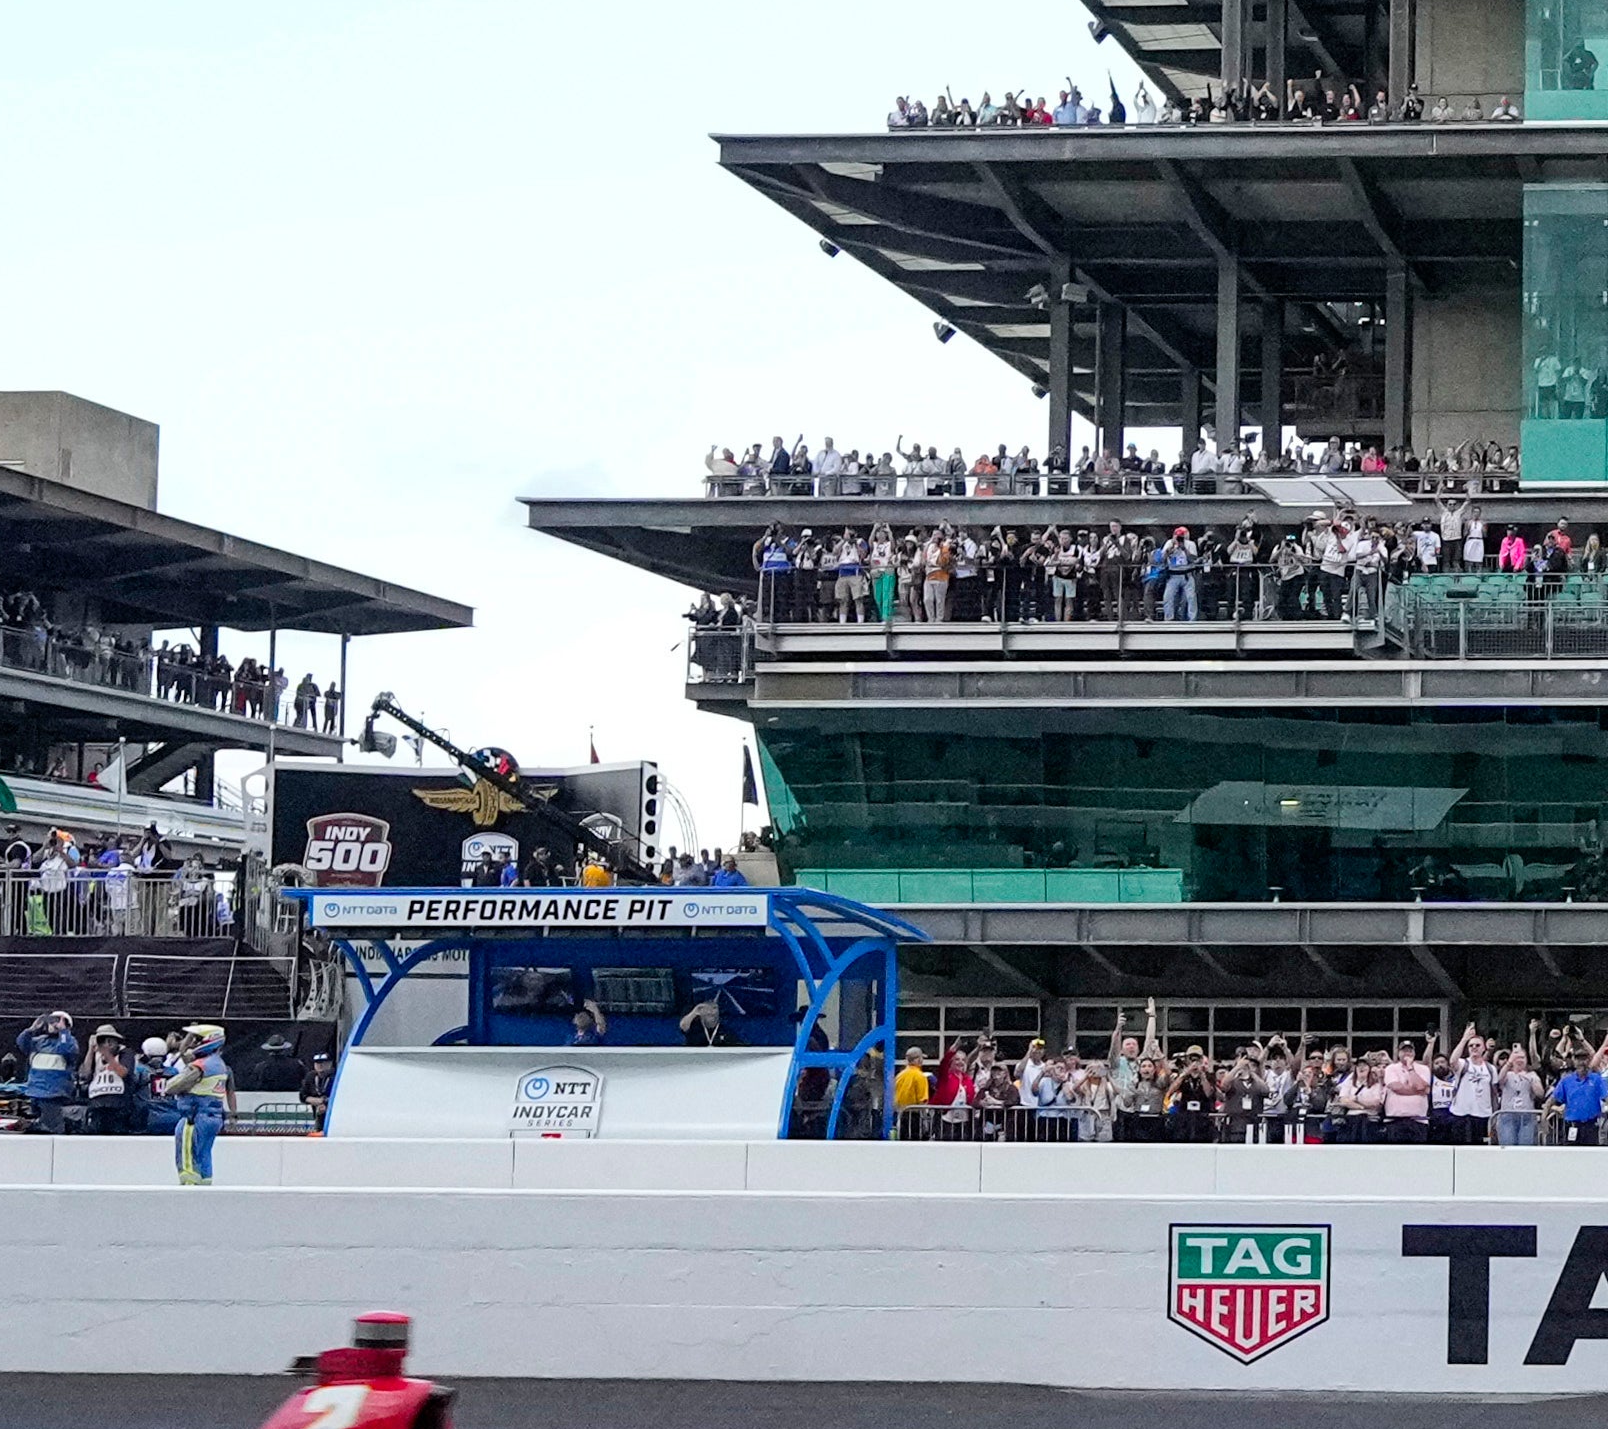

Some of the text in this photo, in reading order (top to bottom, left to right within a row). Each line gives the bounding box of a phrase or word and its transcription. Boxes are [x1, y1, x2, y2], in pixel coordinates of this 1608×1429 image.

[324, 825, 371, 841] INDY
[306, 842, 389, 871] 500
[406, 899, 673, 922] PERFORMANCE PIT
[553, 1082, 591, 1095] NTT
[512, 1105, 593, 1119] INDYCAR
[527, 1118, 573, 1128] SERIES
[1185, 1236, 1311, 1276] TAG
[1182, 1284, 1319, 1349] HEUER
